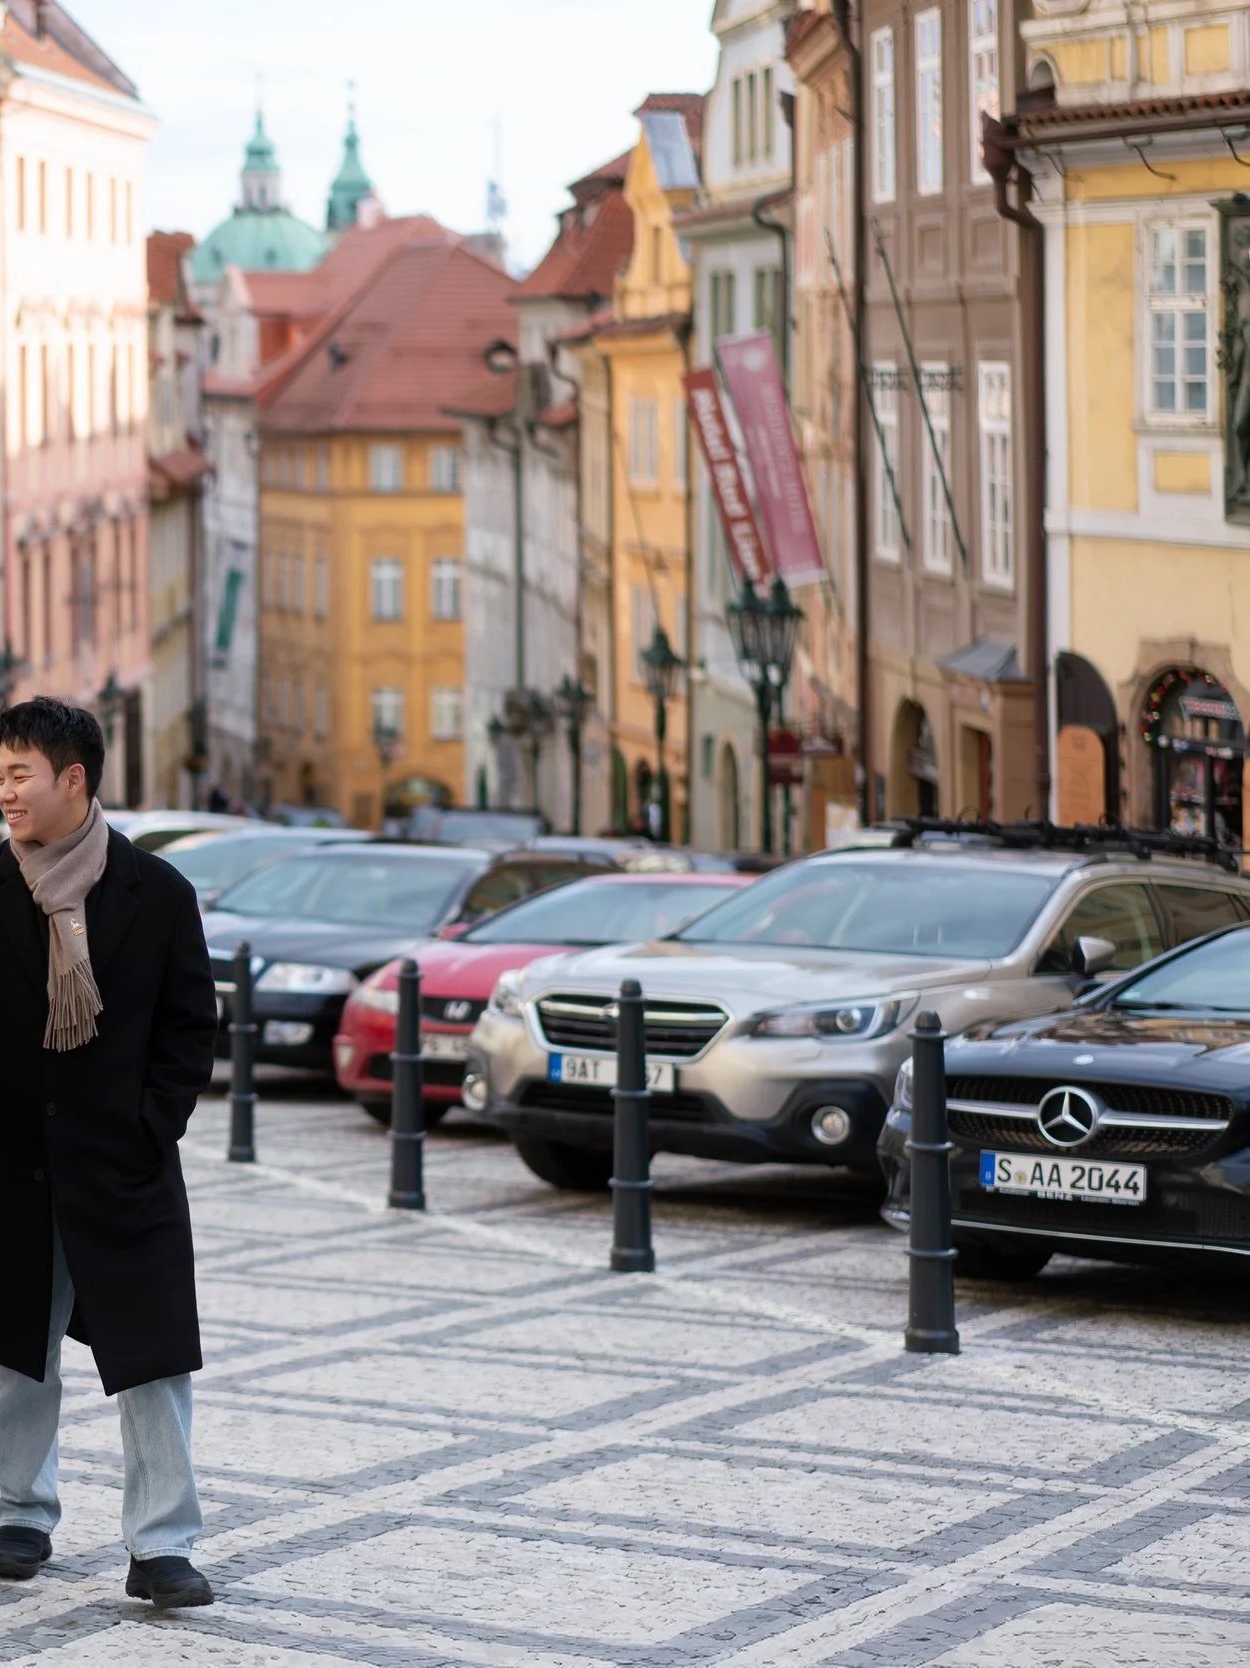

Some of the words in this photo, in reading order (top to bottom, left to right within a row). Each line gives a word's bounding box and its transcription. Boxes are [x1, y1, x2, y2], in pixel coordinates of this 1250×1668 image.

[566, 1057, 600, 1079] 9AT
[997, 1158, 1012, 1183] S
[1030, 1161, 1063, 1189] AA
[1069, 1164, 1140, 1196] 2044
